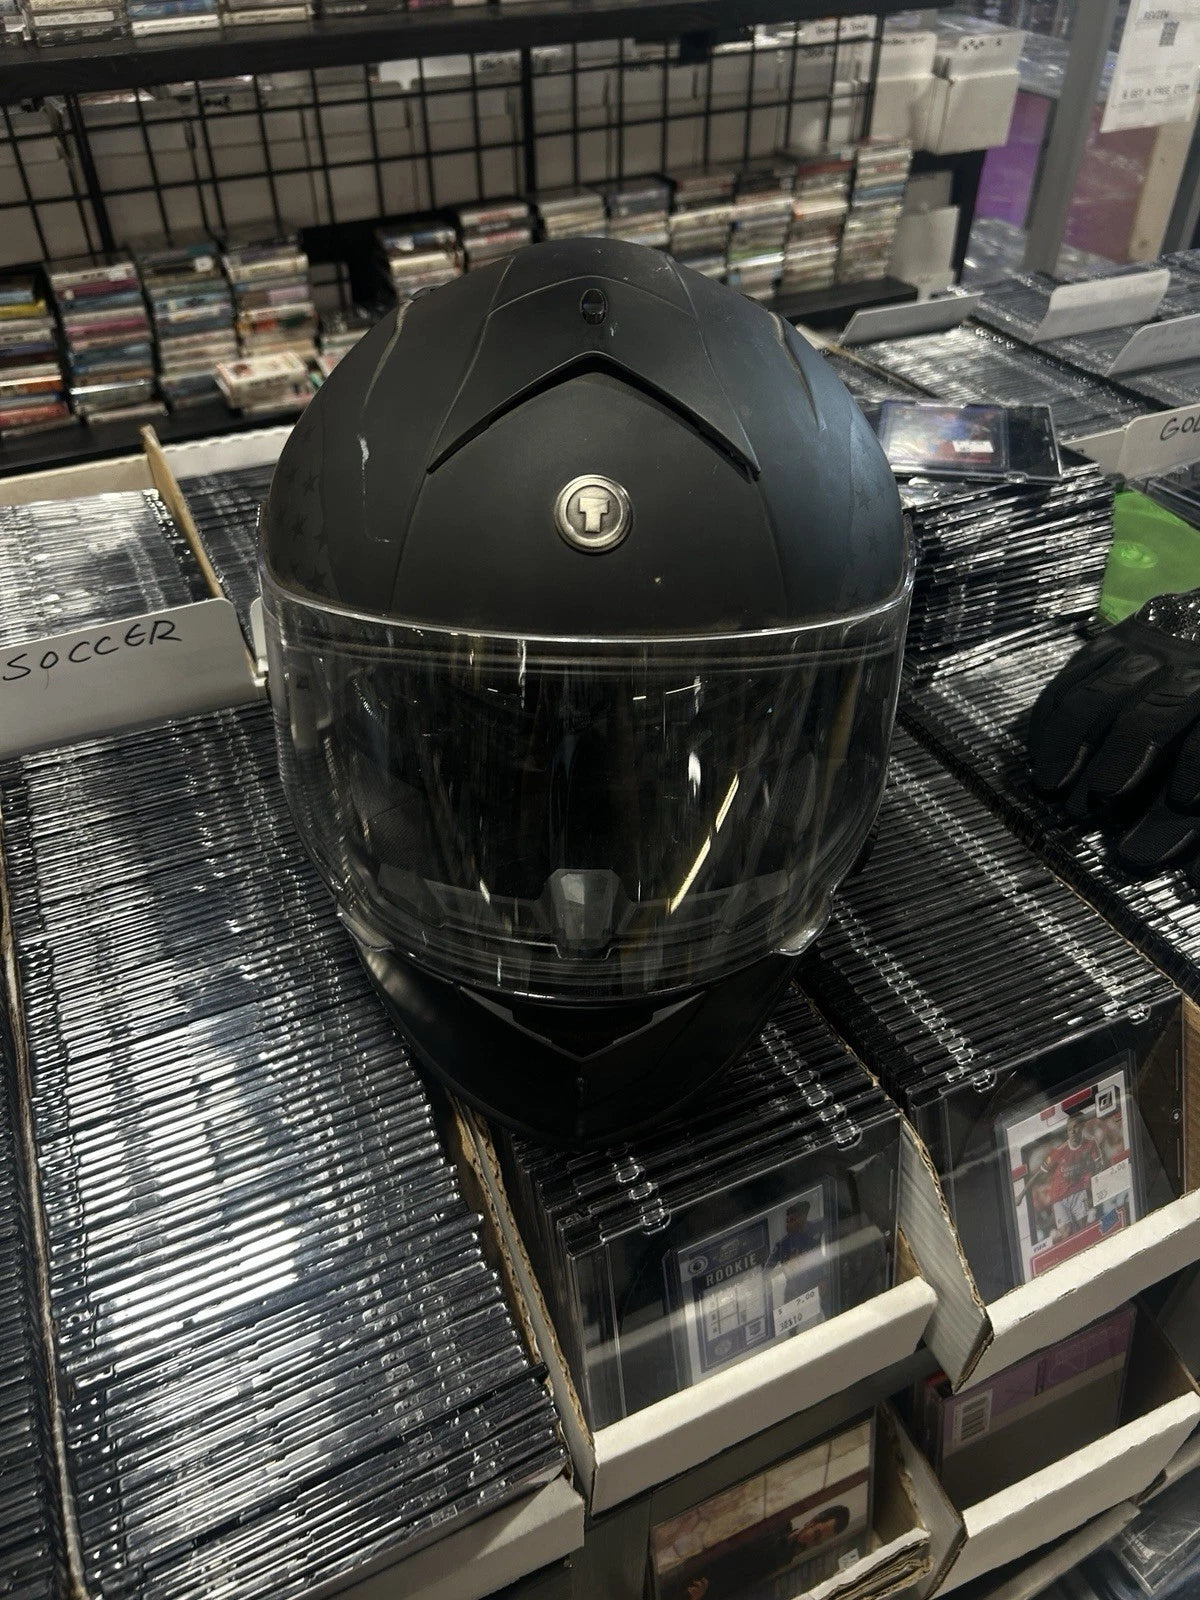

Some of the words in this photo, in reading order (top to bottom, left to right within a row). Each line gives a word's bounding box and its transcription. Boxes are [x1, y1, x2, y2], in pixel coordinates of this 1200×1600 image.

[2, 620, 182, 681] SOCCER
[1033, 1242, 1048, 1254] FIFA
[705, 1252, 758, 1288] ROOKIE
